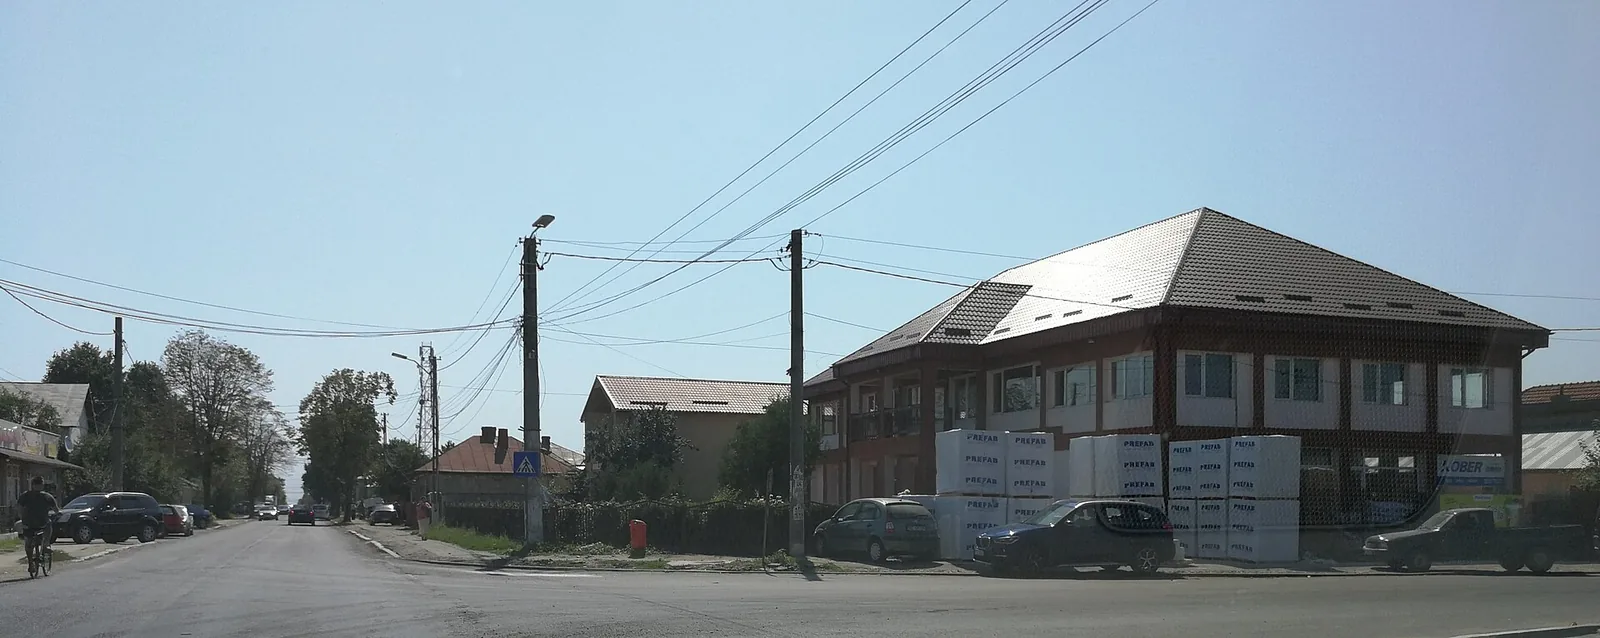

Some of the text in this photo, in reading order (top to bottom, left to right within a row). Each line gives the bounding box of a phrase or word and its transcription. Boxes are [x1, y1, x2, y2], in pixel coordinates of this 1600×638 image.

[967, 433, 998, 442] PREFAB
[966, 455, 998, 463] PREFAB
[965, 477, 997, 485] PREFAB
